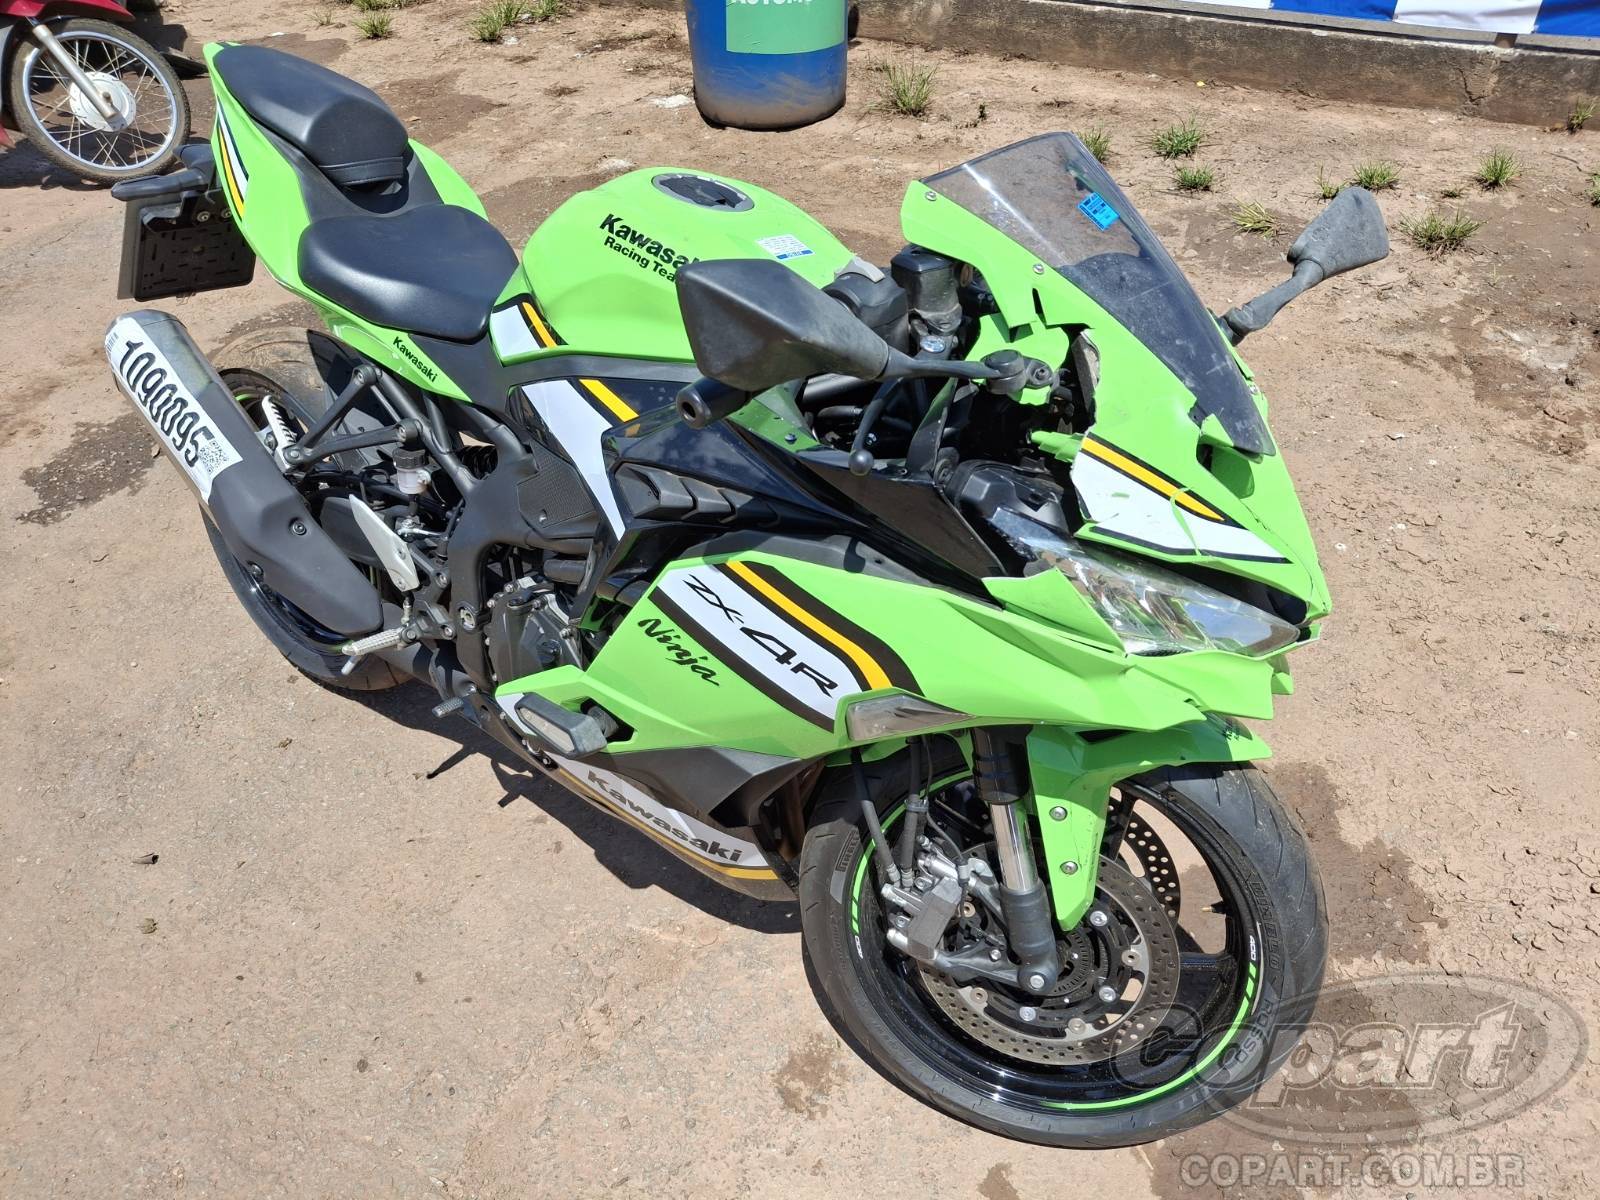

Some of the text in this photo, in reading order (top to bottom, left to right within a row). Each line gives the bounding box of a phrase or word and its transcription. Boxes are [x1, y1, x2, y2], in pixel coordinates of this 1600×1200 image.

[599, 213, 700, 269] Kawasa
[603, 236, 676, 282] Racing Tea
[392, 336, 438, 383] Kawasaki
[119, 340, 215, 468] 1090095
[637, 618, 720, 687] Ninja
[682, 573, 838, 698] ZX-4R
[587, 769, 743, 862] Kawasaki
